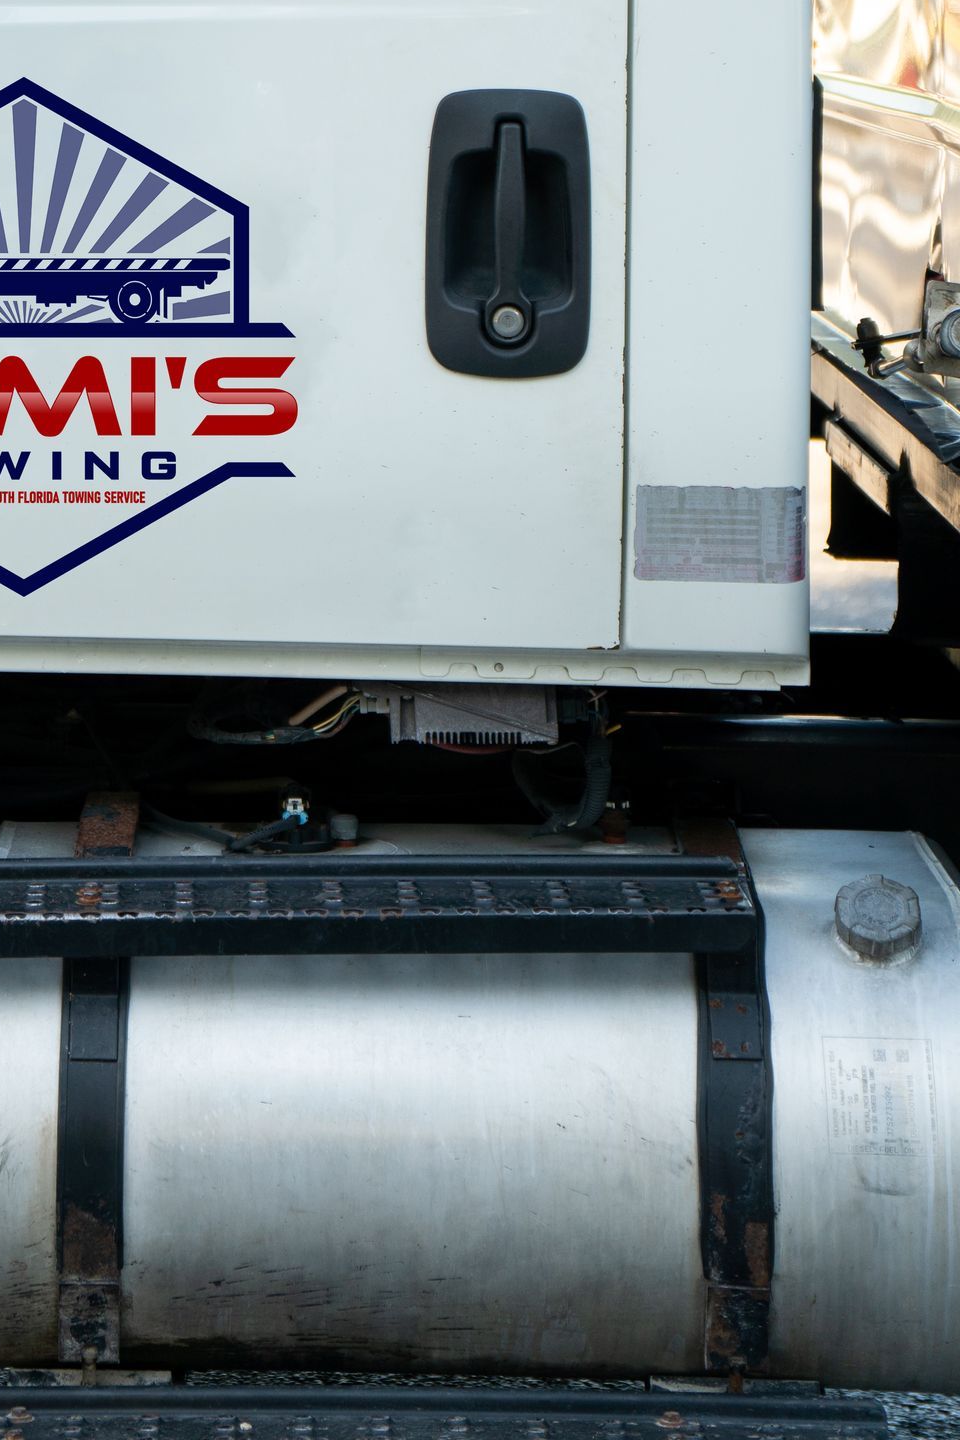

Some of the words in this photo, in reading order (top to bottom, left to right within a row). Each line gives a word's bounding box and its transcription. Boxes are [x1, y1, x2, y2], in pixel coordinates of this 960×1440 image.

[17, 490, 60, 504] FLORIDA
[62, 490, 101, 504] TOWING
[103, 490, 145, 504] SERVICE
